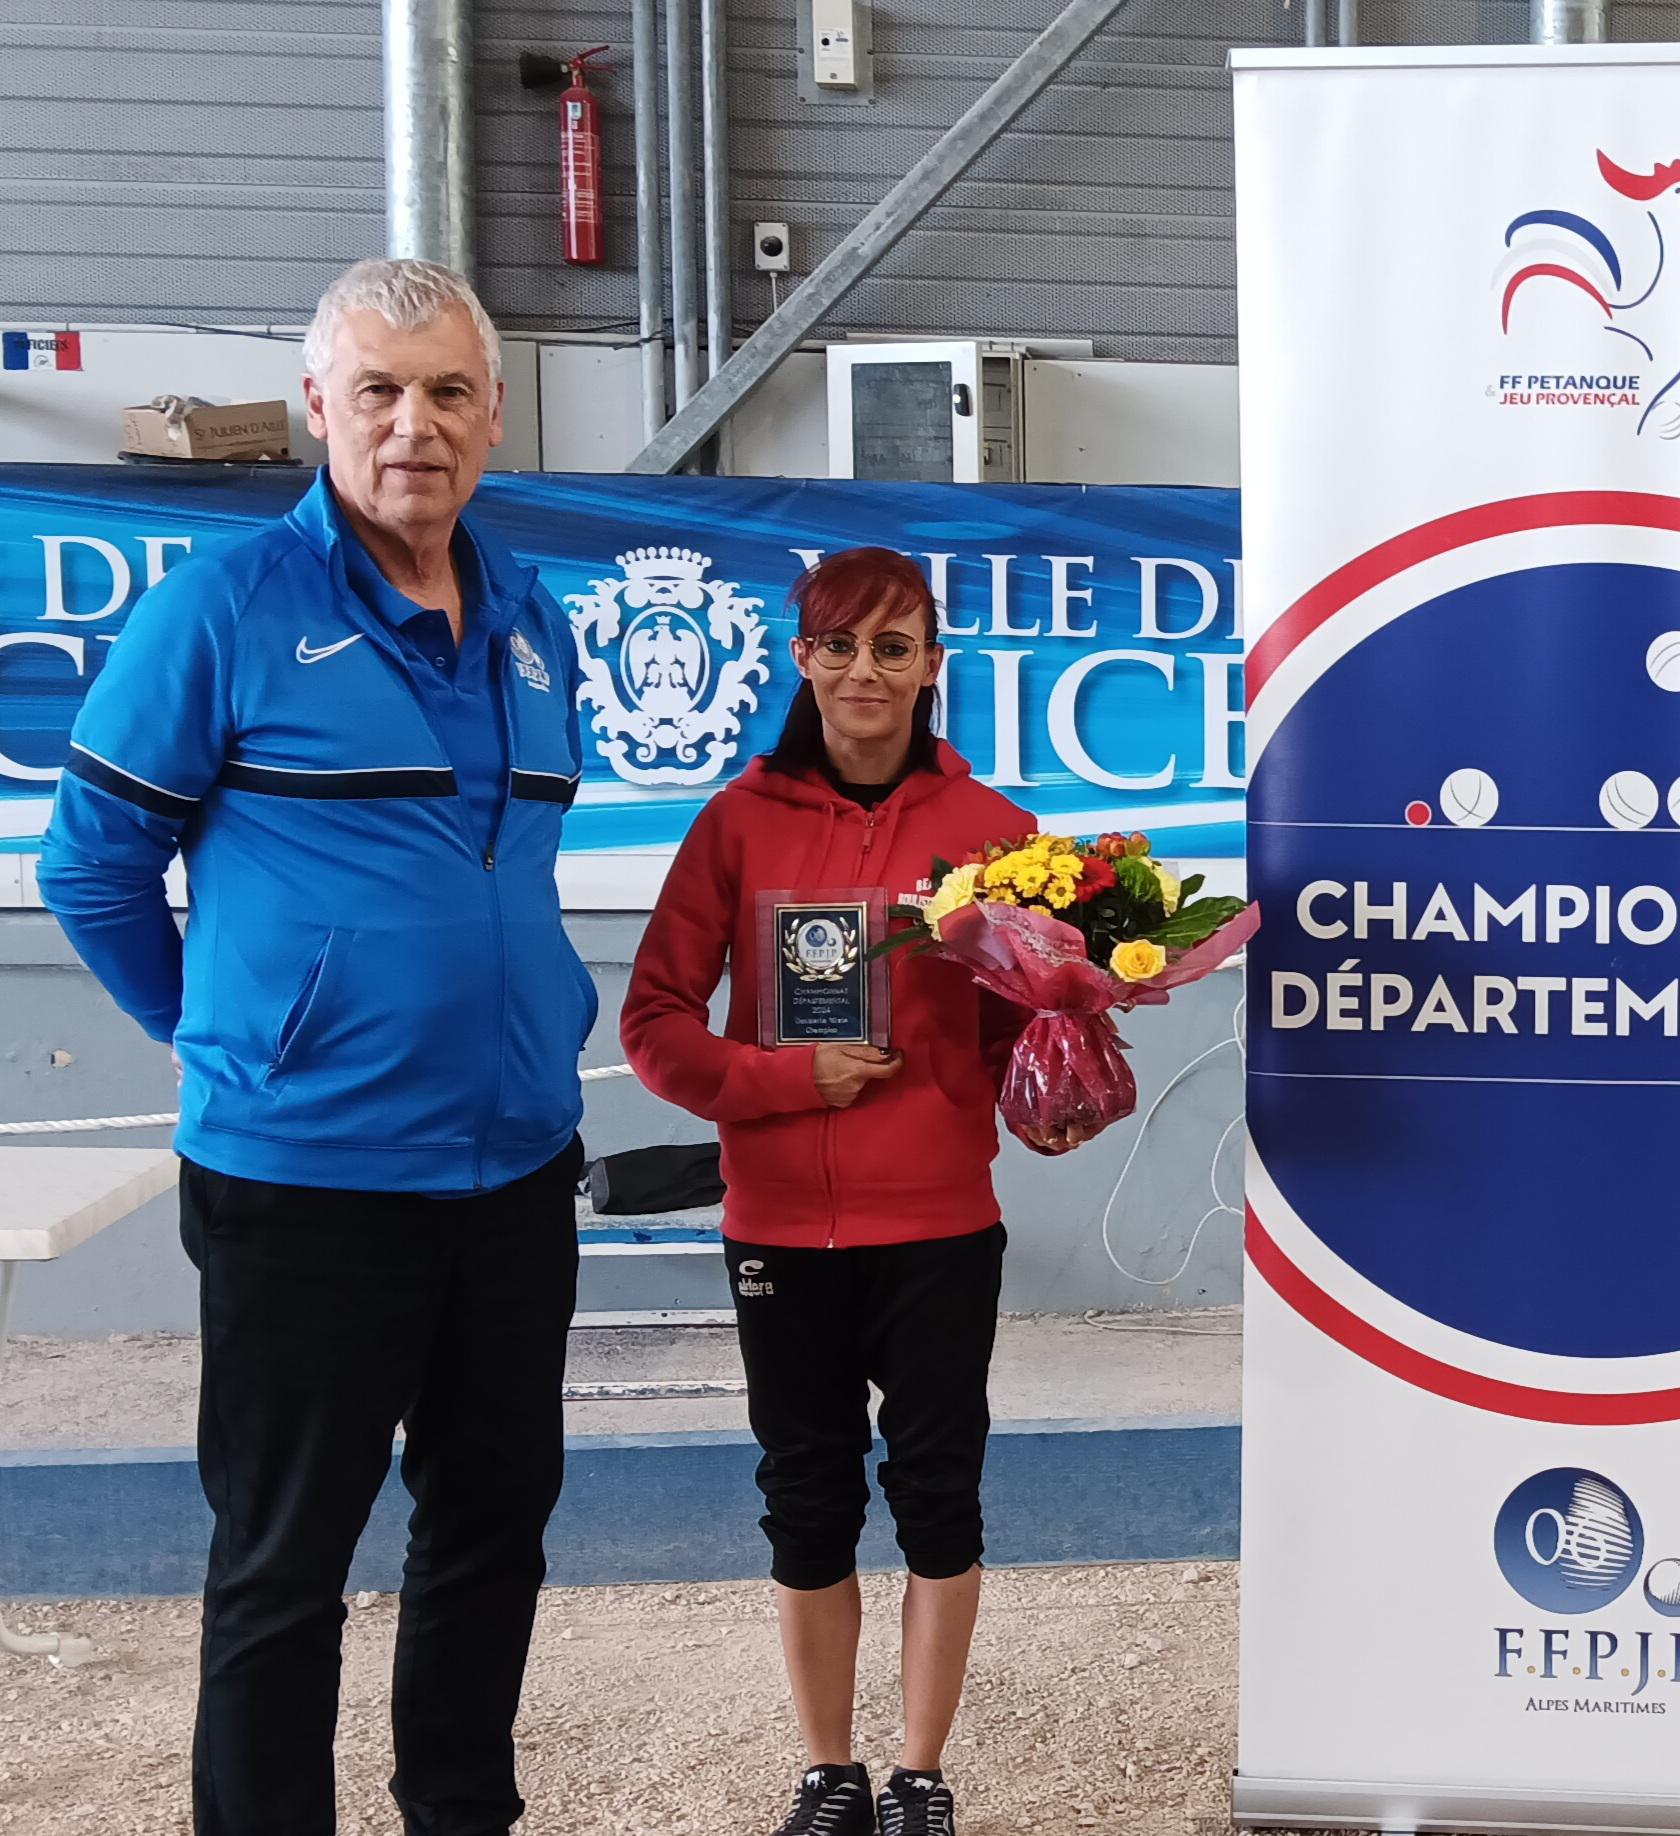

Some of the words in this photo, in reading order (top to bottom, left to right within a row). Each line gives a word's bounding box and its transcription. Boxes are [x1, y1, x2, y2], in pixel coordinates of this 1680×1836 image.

[1499, 375, 1523, 390] FF
[1527, 375, 1640, 392] PETANQUE
[1499, 392, 1532, 406] JEU
[1536, 392, 1640, 408] PROVENÇAL
[935, 648, 1246, 791] ICE
